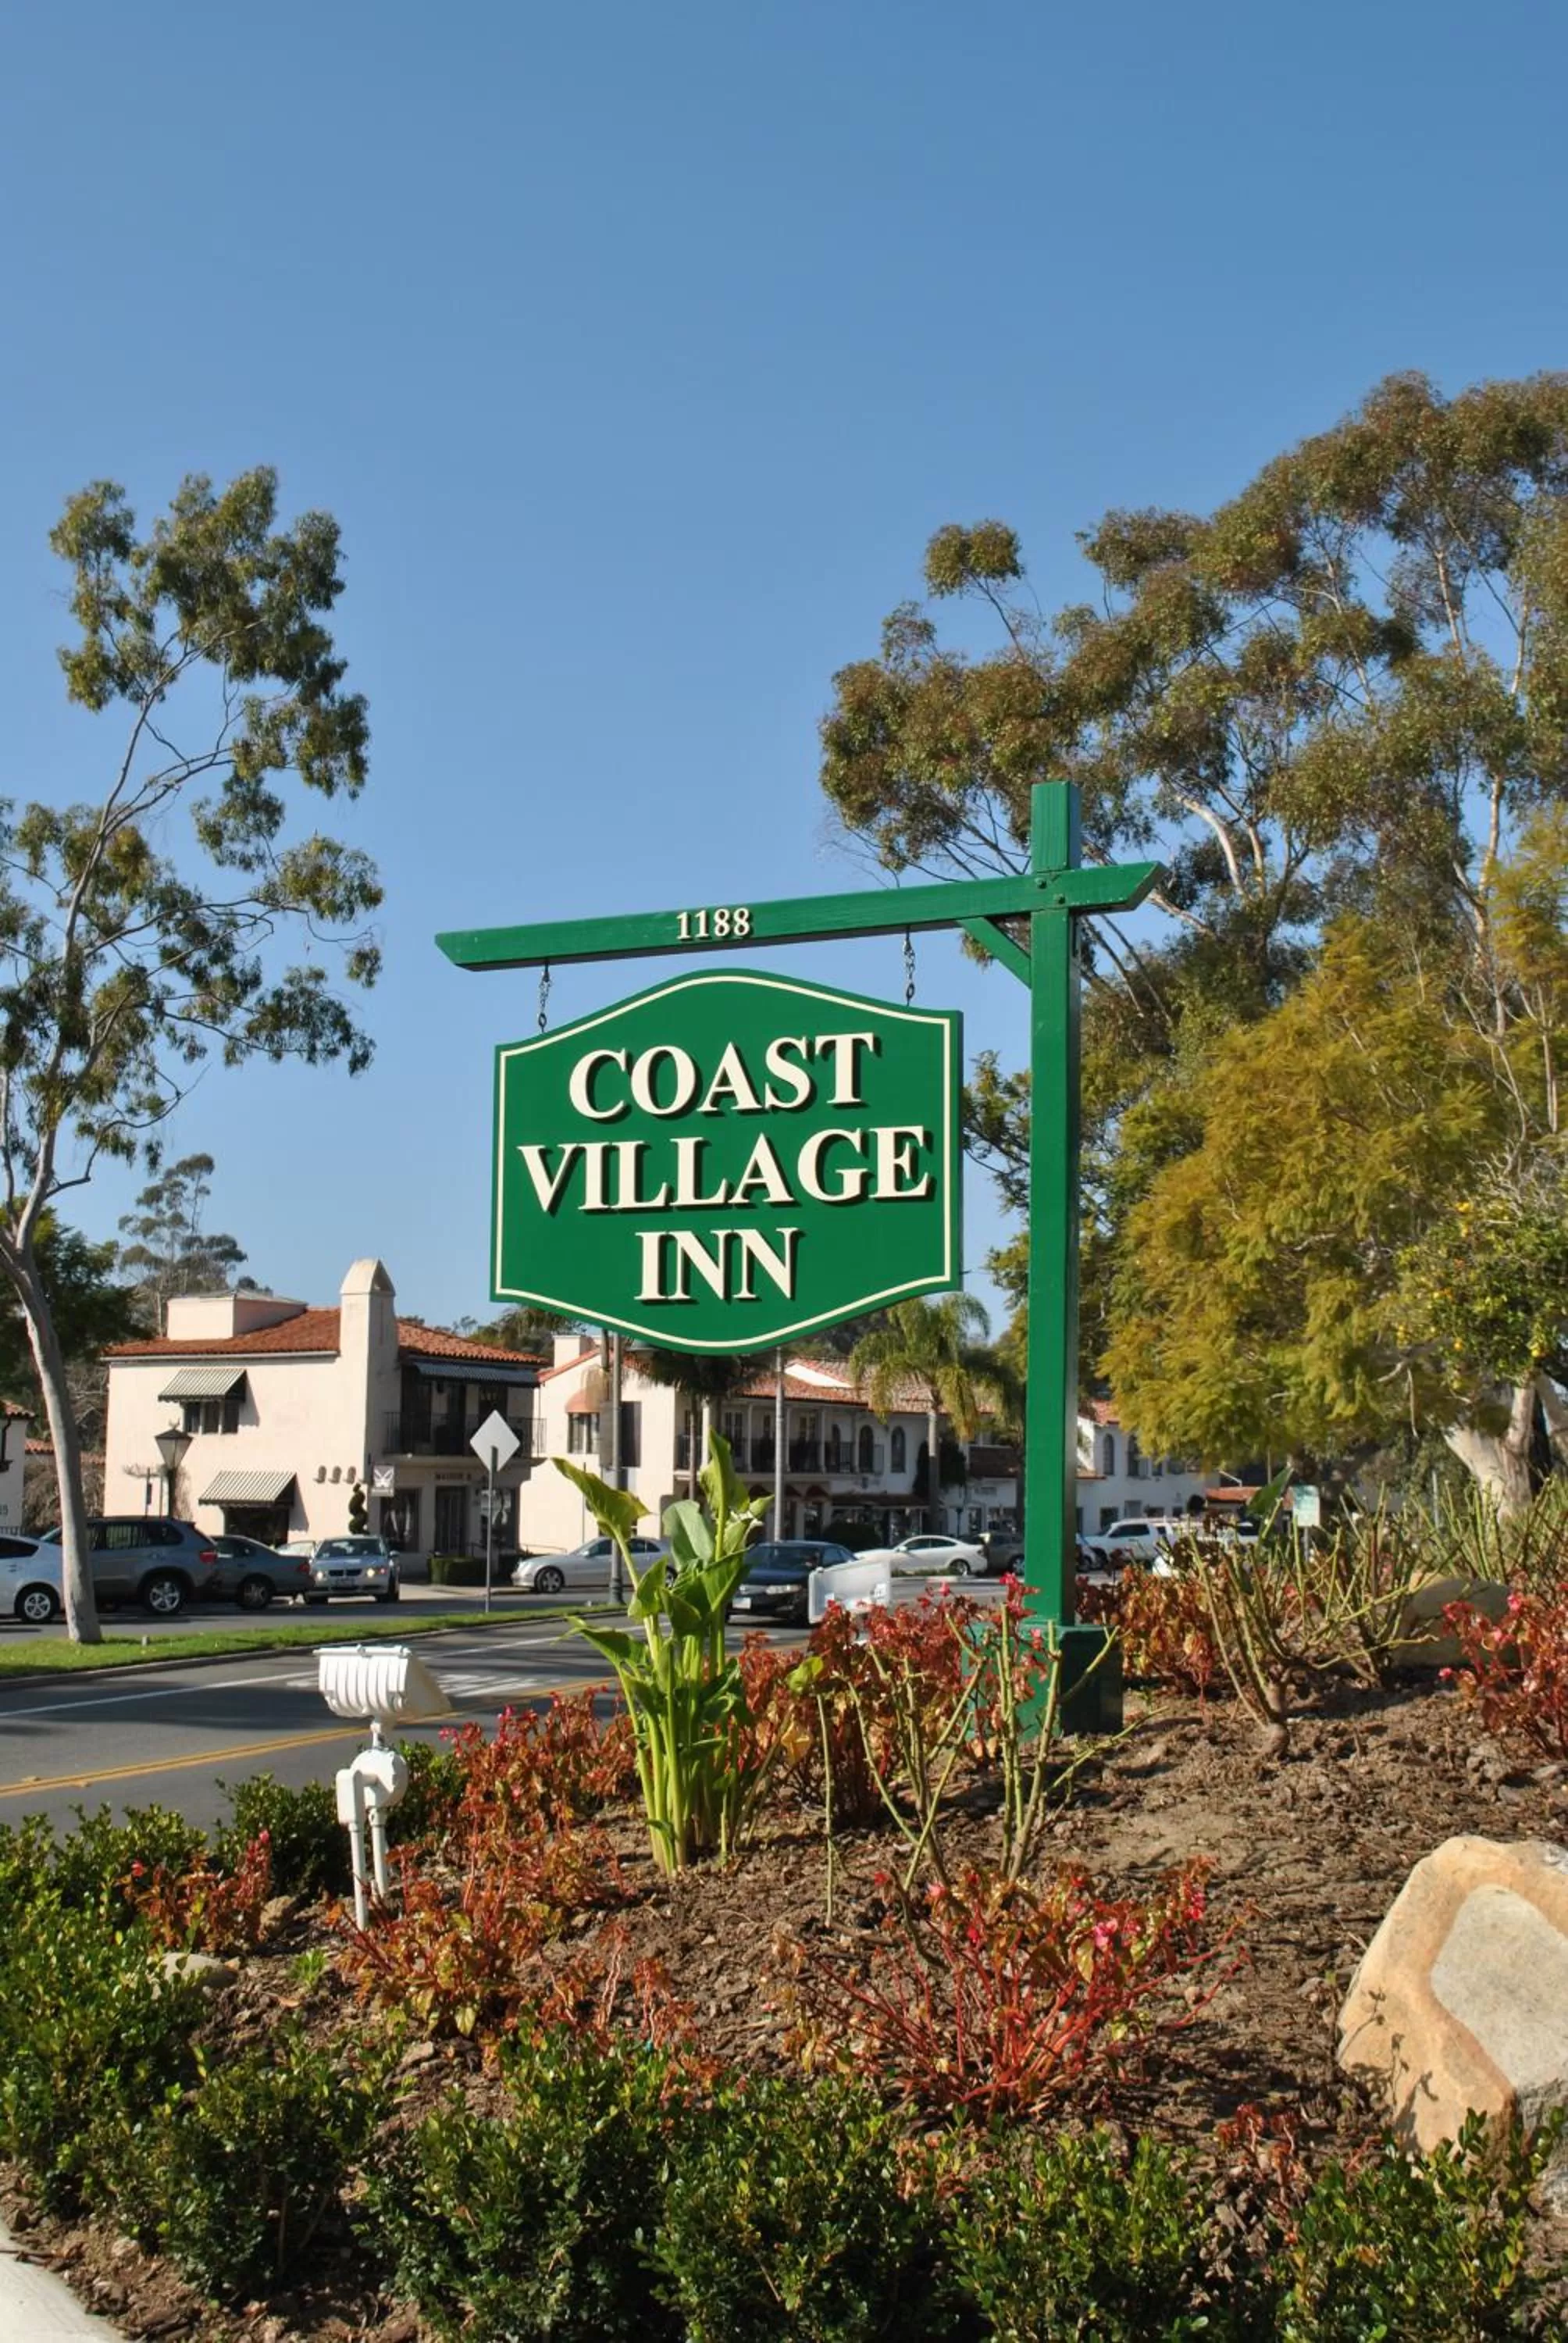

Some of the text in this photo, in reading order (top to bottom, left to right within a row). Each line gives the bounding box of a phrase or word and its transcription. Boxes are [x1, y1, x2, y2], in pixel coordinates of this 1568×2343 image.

[676, 907, 750, 939] 1188
[569, 1032, 875, 1118] COAST
[518, 1125, 930, 1212] VILLAGE
[635, 1227, 798, 1300] INN
